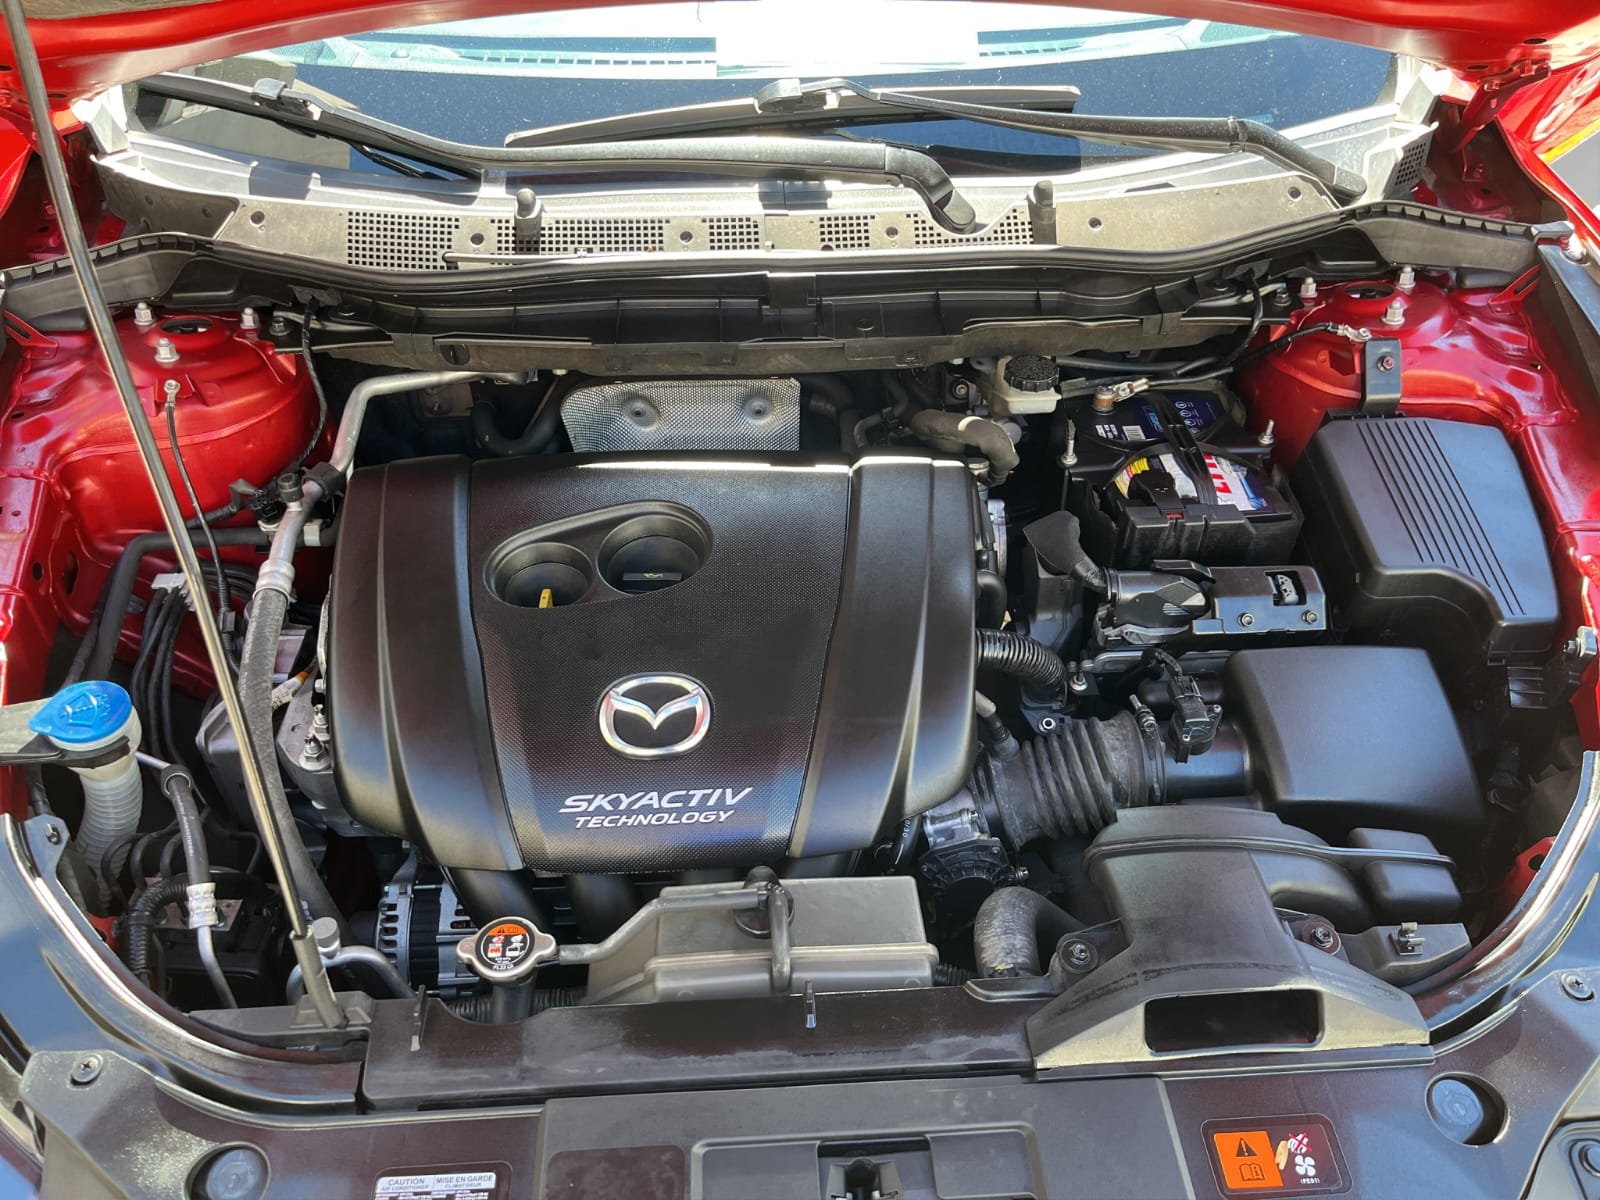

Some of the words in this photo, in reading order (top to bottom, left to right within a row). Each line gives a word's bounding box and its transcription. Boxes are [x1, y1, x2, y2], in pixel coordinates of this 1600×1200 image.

[559, 787, 753, 813] SKYACTIV
[575, 810, 735, 829] TECHNOLOGY
[388, 1177, 425, 1186] CAUTION
[436, 1175, 454, 1184] MISE
